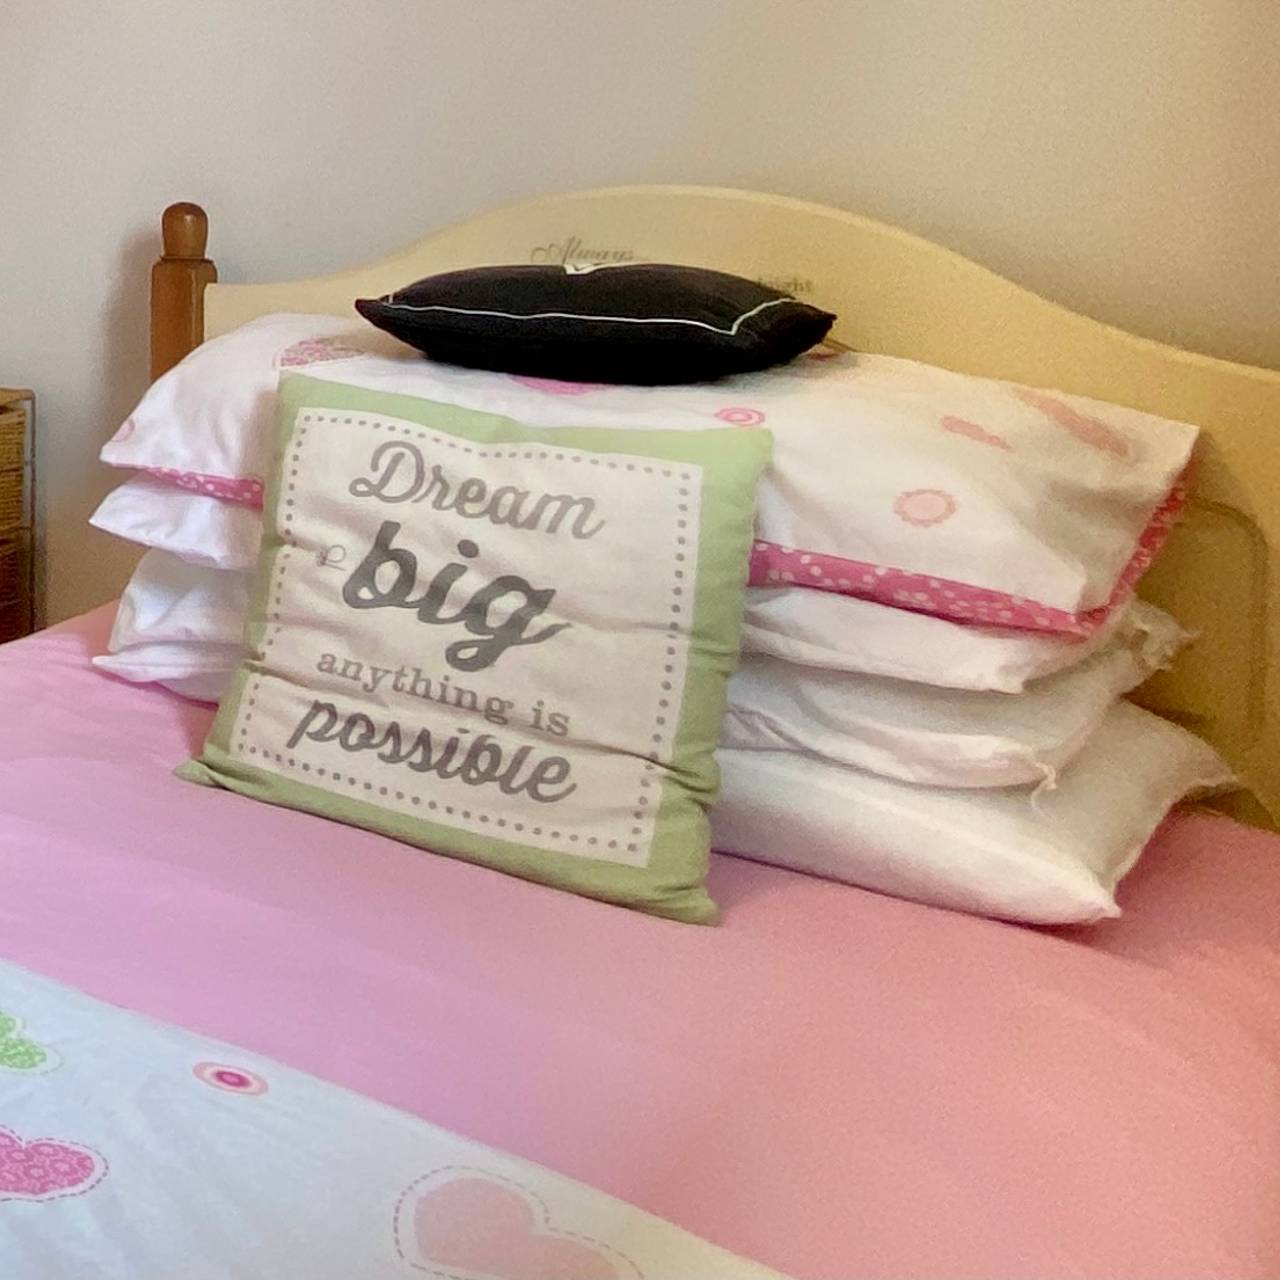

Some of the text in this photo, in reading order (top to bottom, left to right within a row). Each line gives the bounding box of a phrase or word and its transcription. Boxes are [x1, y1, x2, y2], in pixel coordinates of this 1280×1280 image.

[348, 440, 604, 540] Dream
[342, 520, 572, 672] big
[317, 650, 570, 737] anything is
[287, 698, 577, 803] possible
